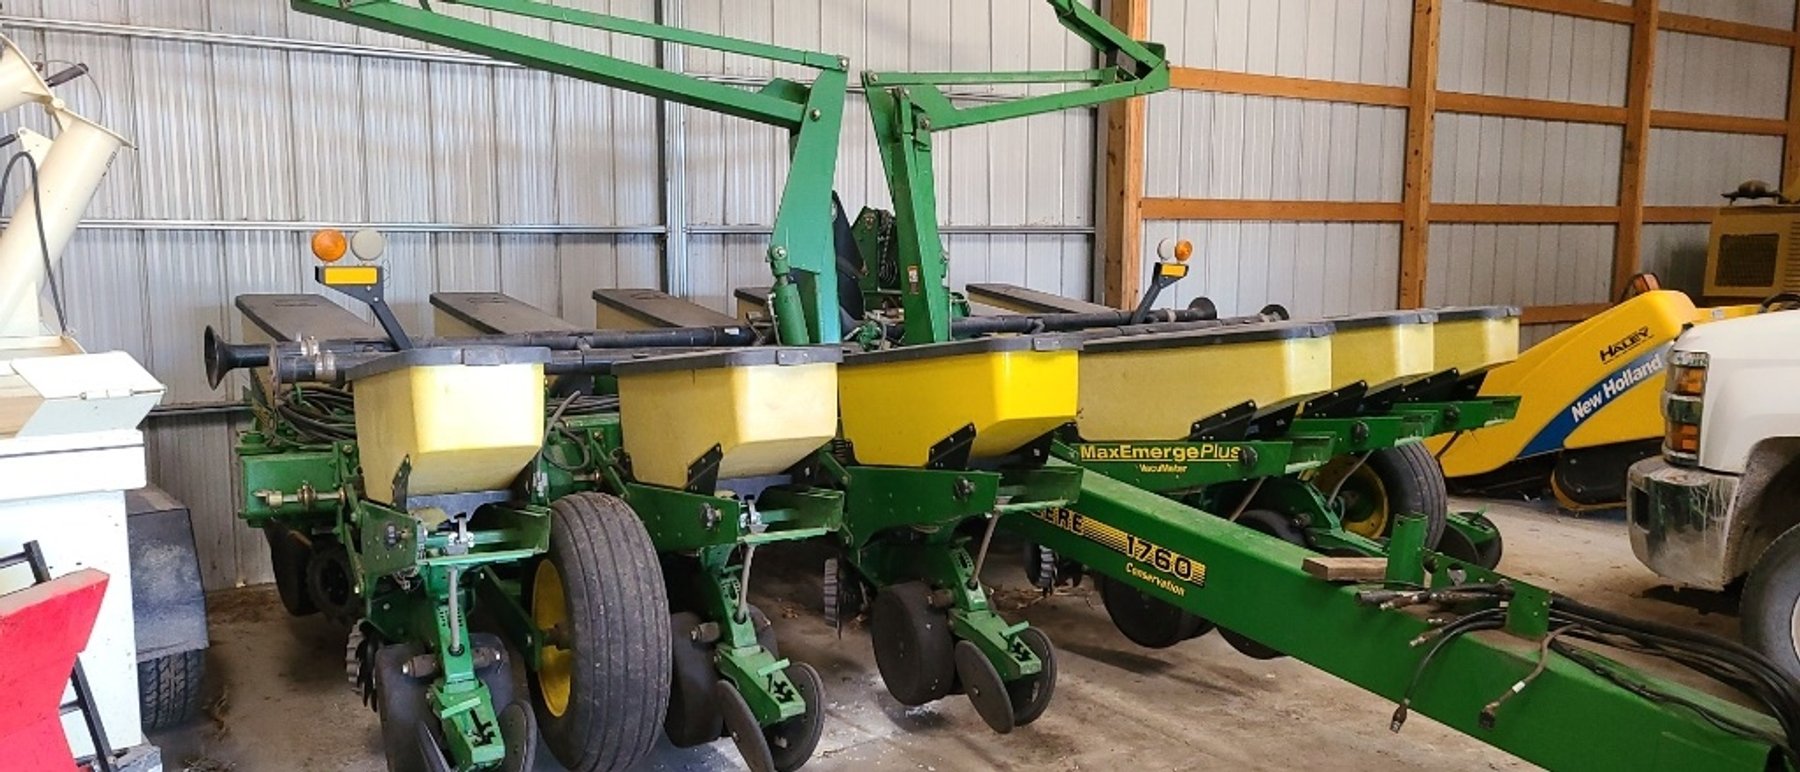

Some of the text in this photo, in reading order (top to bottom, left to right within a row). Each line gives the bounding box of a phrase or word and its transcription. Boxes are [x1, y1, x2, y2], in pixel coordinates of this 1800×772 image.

[1600, 326, 1649, 361] HALEY
[1571, 353, 1662, 423] New Holland
[1033, 507, 1193, 581] ERE 1760
[1126, 562, 1186, 597] Conservation
